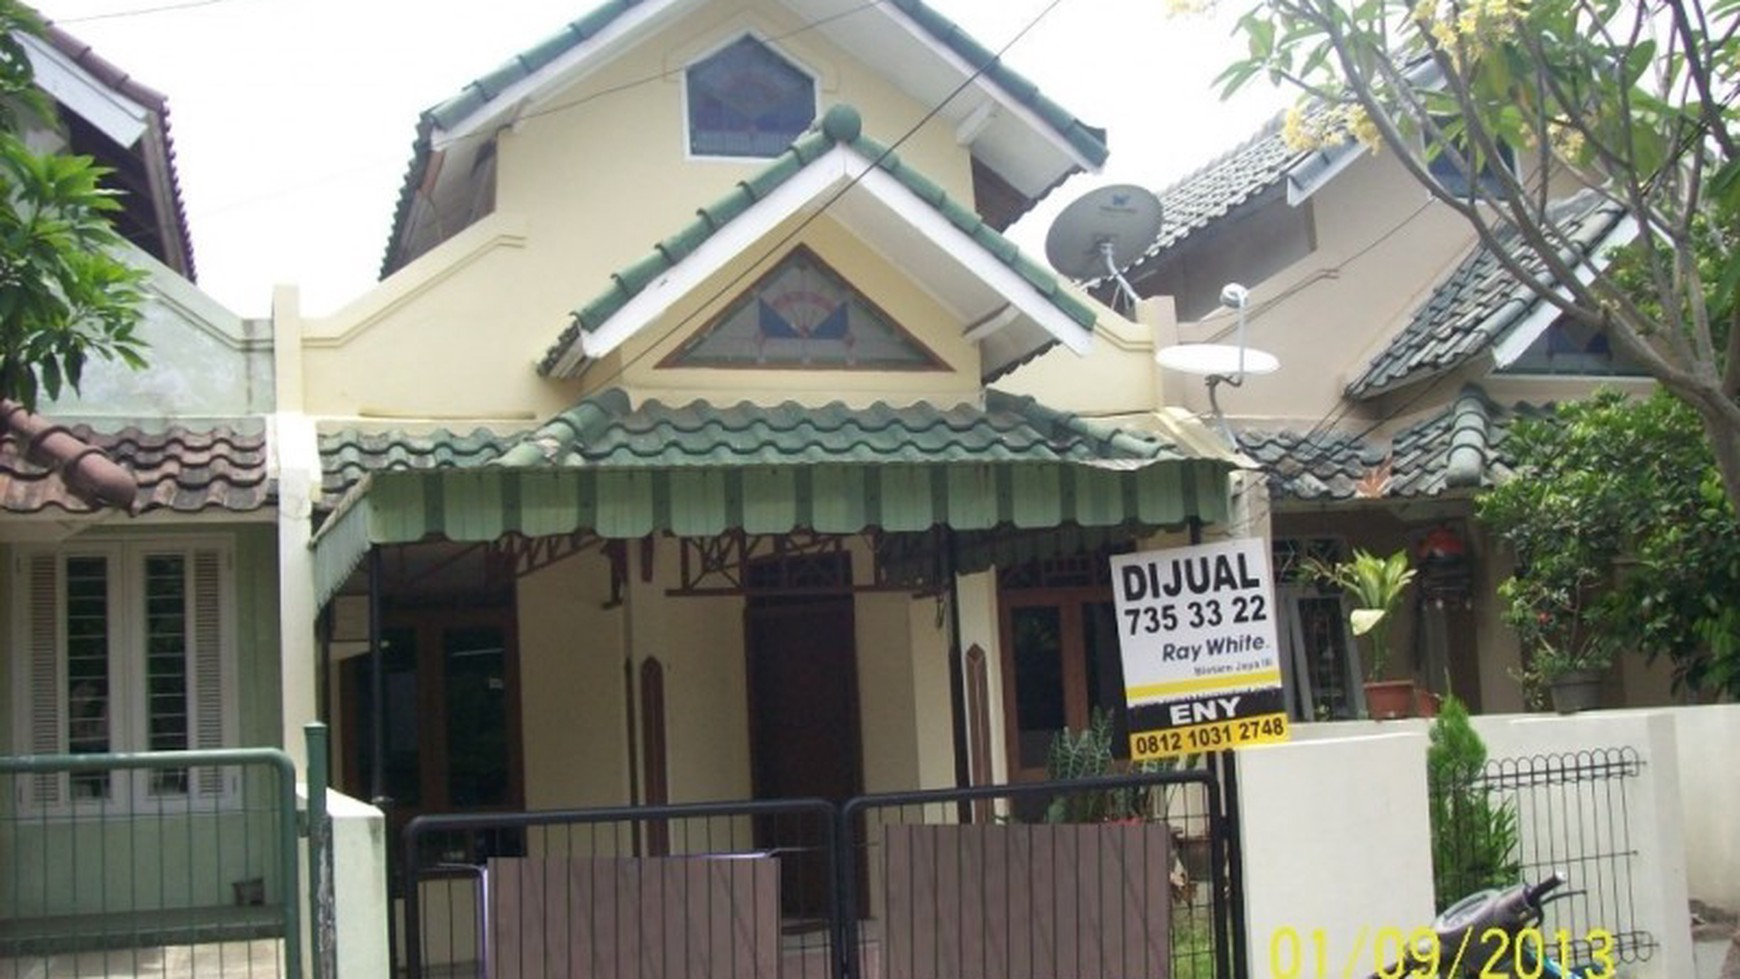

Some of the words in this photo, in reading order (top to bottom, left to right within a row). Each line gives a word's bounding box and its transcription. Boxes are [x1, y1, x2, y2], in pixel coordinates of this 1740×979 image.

[1122, 552, 1260, 602] DIJUAL
[1124, 605, 1178, 635] 735
[1187, 599, 1223, 628] 33
[1231, 595, 1267, 623] 22
[1162, 643, 1202, 662] Ray
[1169, 696, 1241, 726] ENY
[1136, 731, 1182, 754] 0812
[1187, 724, 1233, 748] 1031
[1239, 717, 1284, 740] 2748
